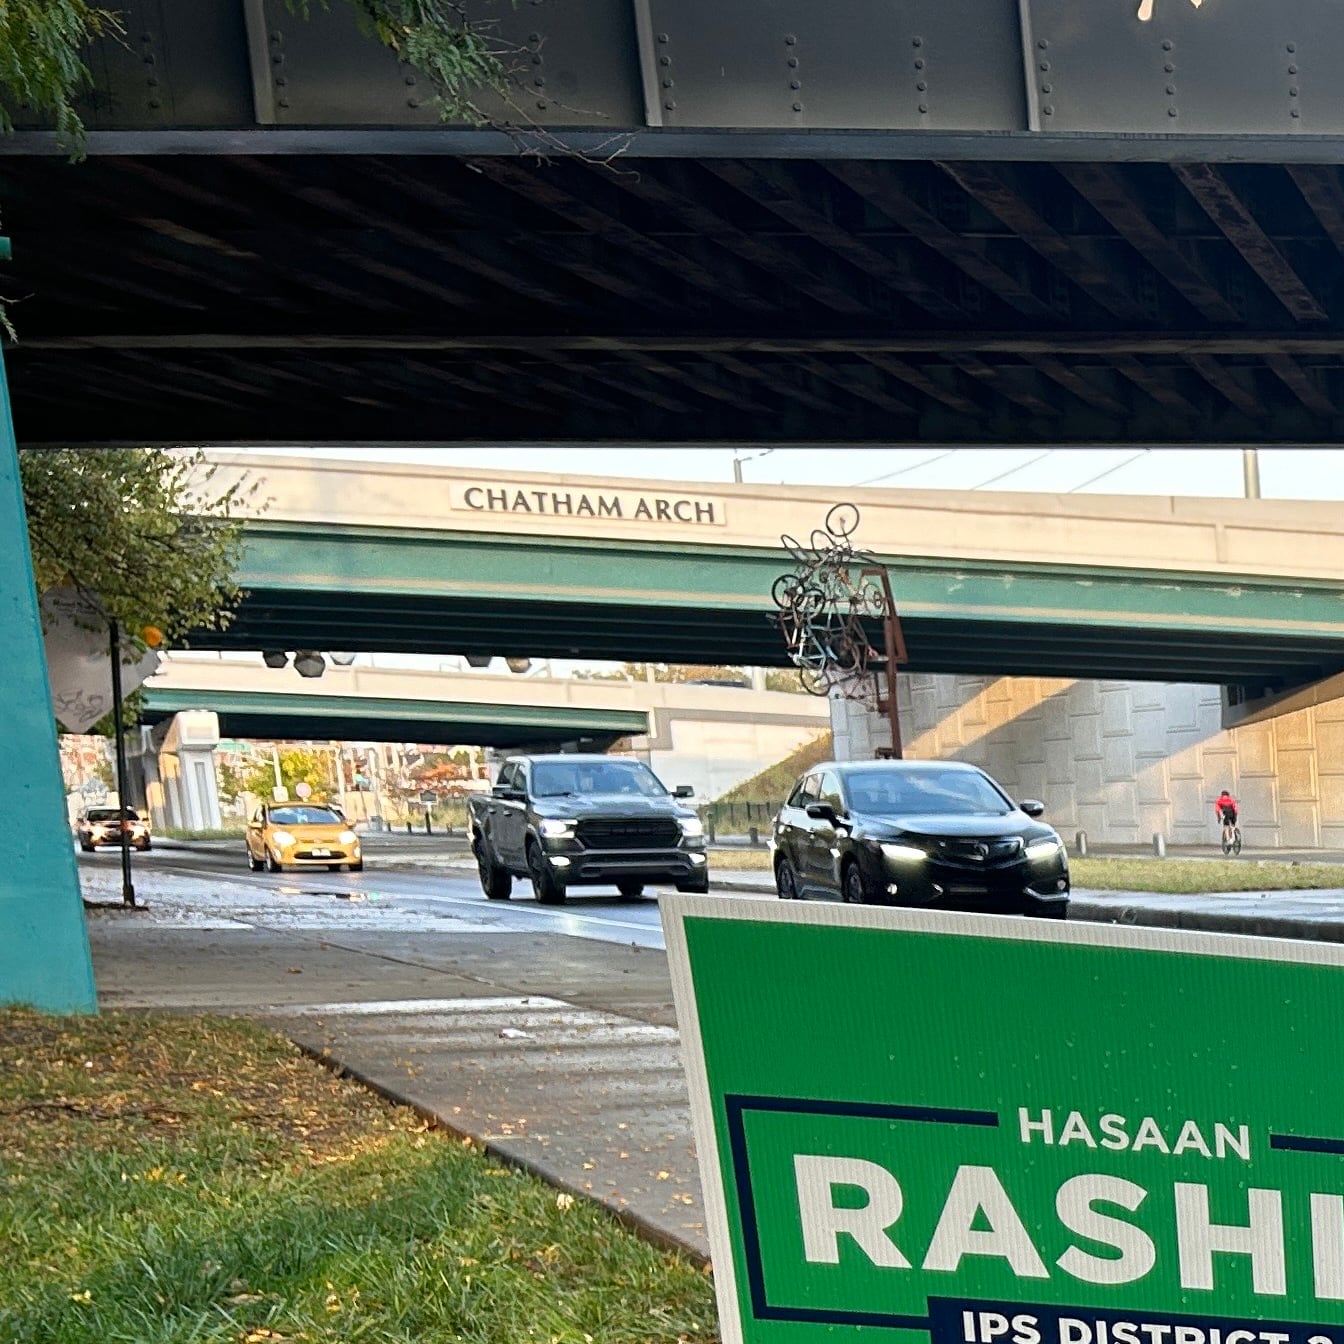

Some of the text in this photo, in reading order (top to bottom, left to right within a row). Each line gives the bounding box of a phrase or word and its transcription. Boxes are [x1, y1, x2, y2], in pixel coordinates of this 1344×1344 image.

[464, 487, 715, 523] CHATHAM ARCH
[1018, 1107, 1251, 1161] HASAAN
